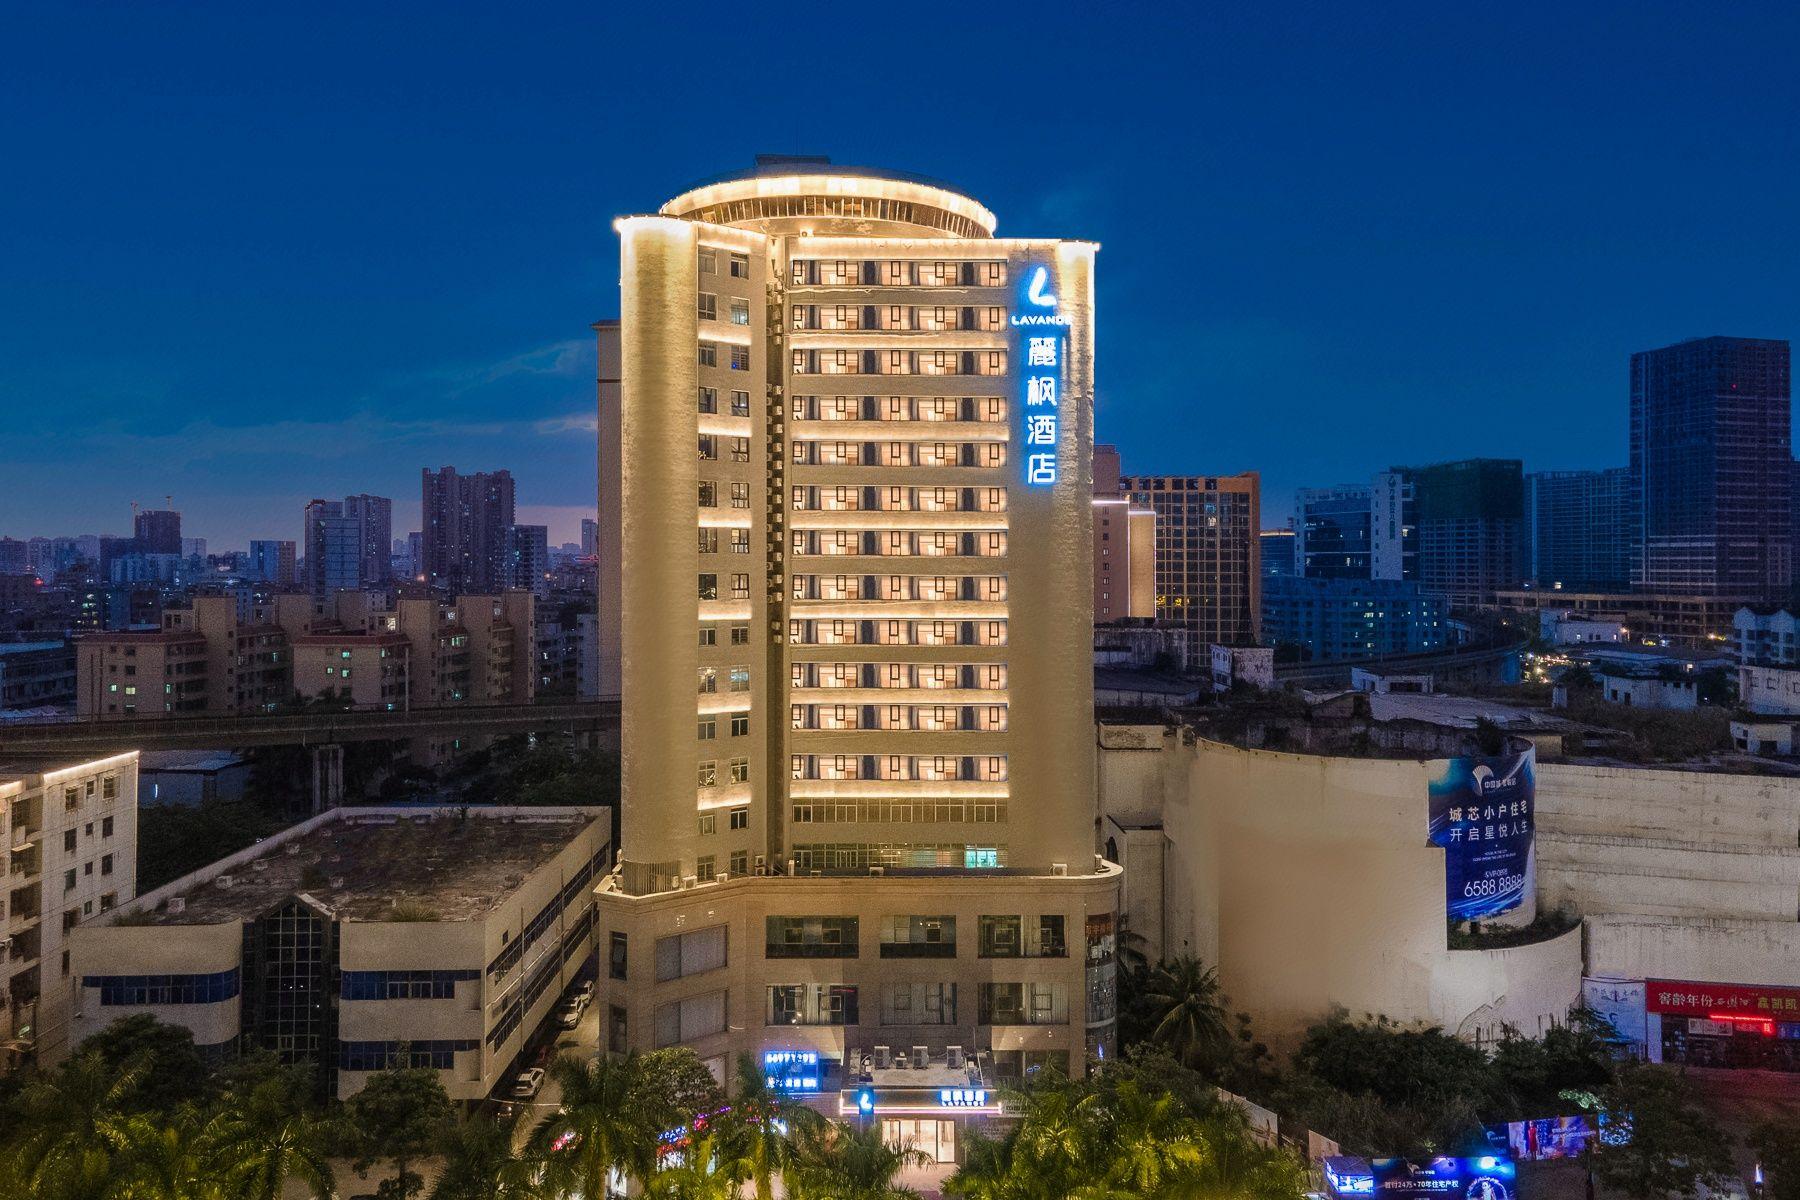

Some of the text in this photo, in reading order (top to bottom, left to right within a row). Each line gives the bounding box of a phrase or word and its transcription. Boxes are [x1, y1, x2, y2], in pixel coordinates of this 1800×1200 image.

[1449, 800, 1527, 821] 城芯小户住宅
[1450, 820, 1528, 841] 开启星悦人生
[1464, 873, 1522, 897] 6588 8888
